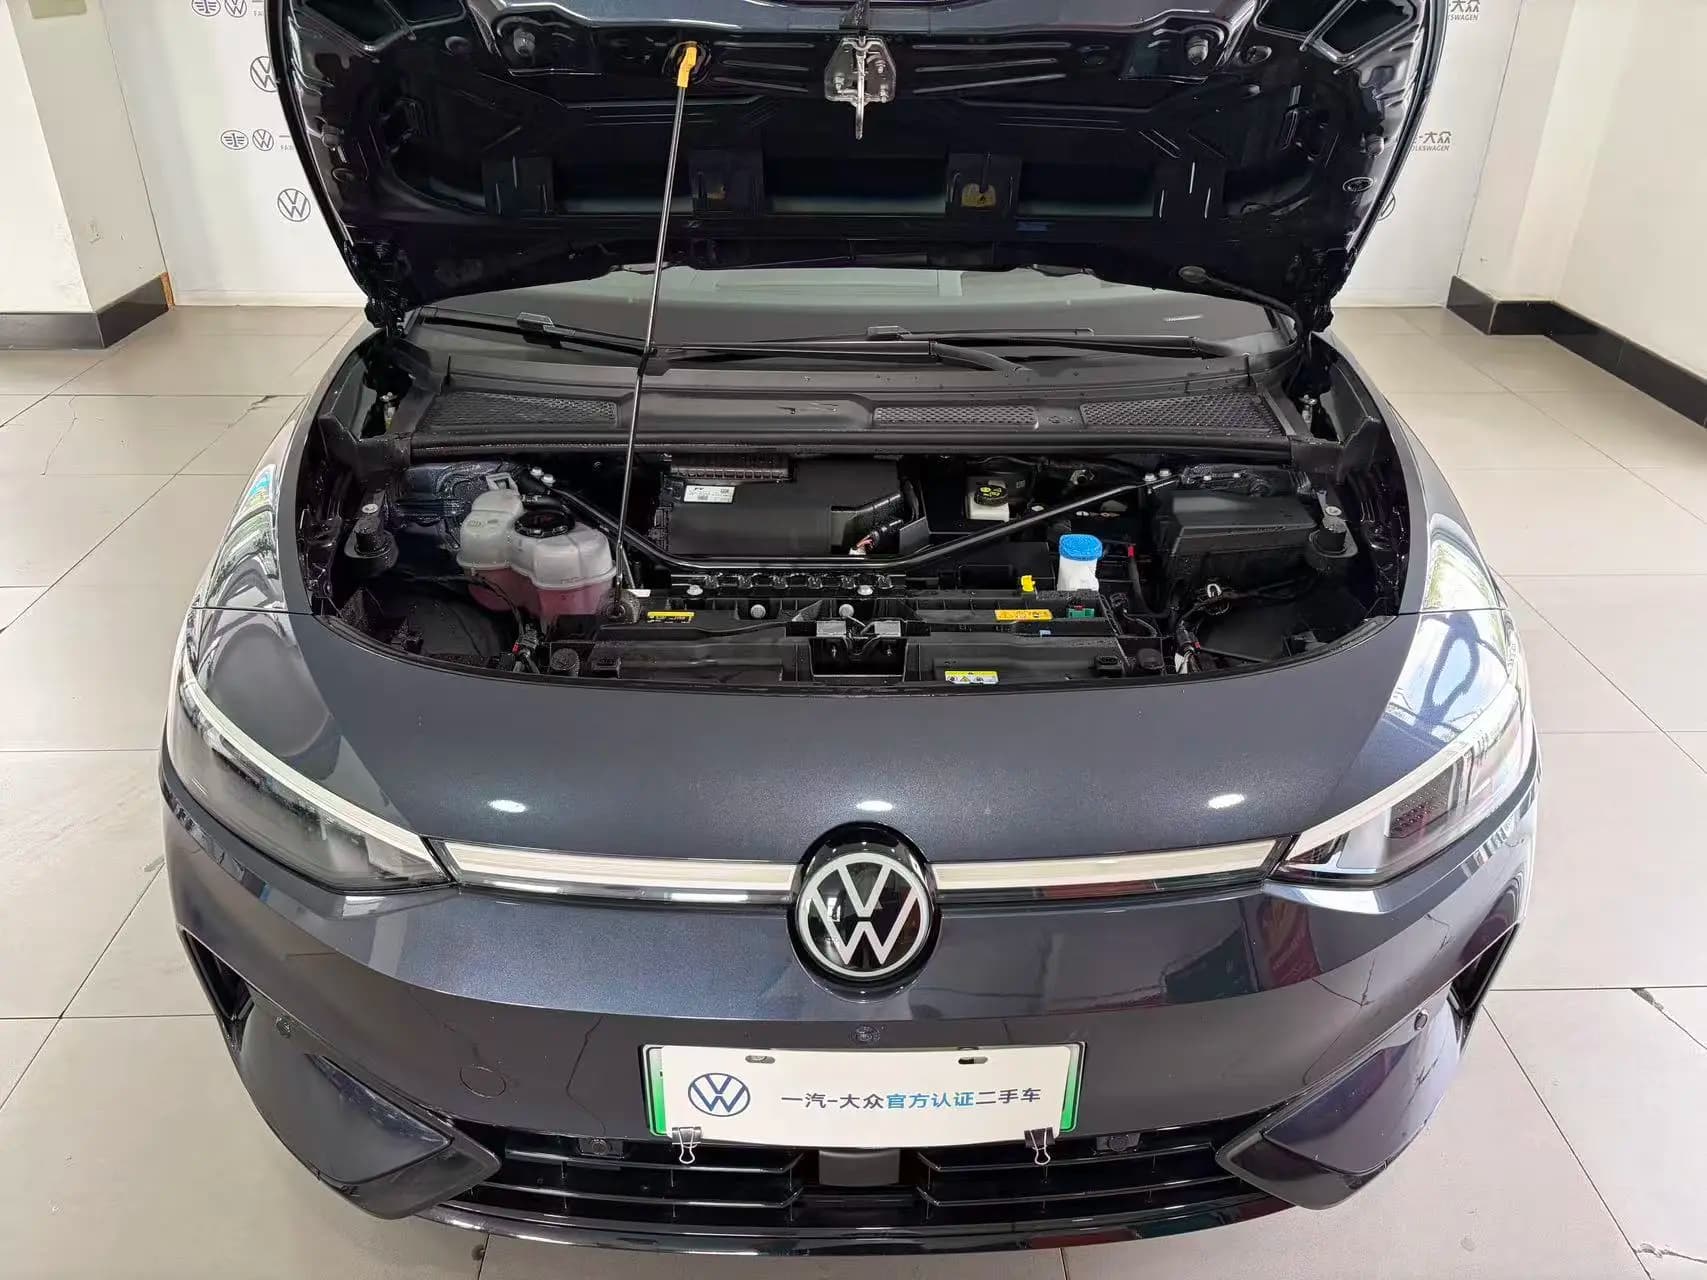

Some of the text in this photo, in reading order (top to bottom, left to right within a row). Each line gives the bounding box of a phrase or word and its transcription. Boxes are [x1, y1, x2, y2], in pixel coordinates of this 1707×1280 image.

[781, 1087, 1042, 1111] 一汽-大众官方认证二手车
